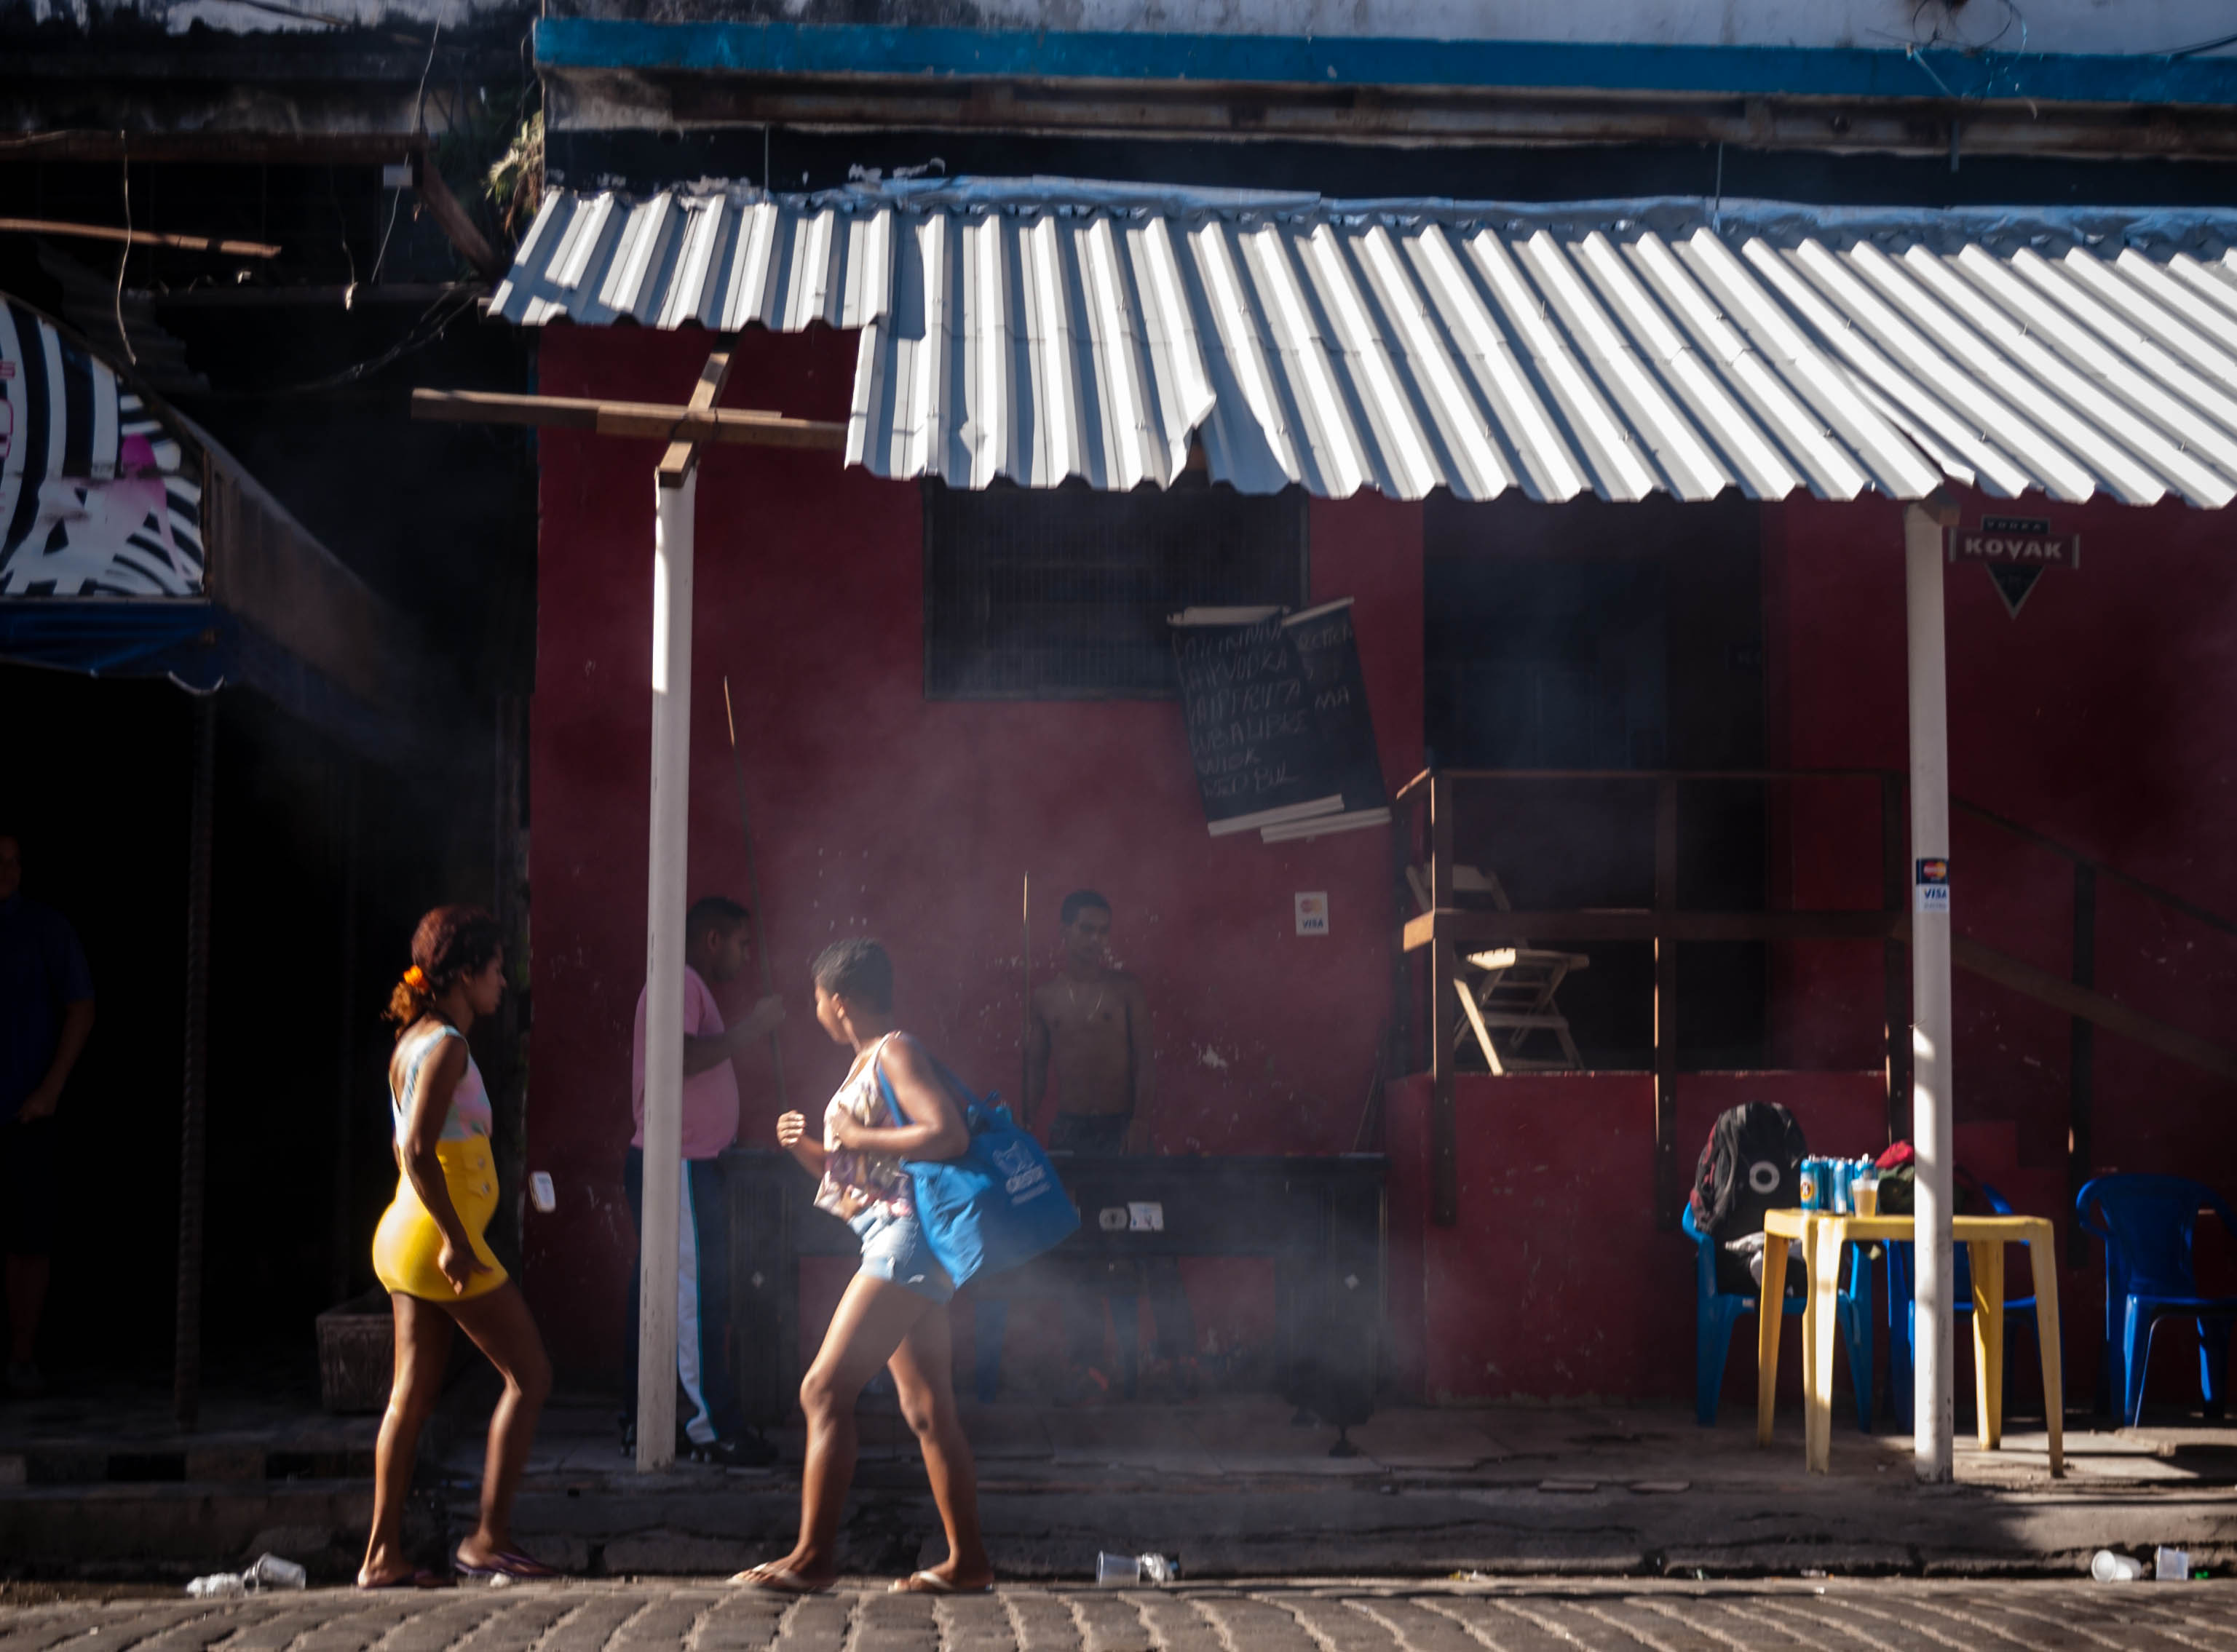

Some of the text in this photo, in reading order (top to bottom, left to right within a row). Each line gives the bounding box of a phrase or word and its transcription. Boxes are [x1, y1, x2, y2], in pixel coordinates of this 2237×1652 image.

[1964, 536, 2062, 561] KOVAK
[1924, 888, 1947, 900] VISA
[1304, 918, 1324, 929] VISA
